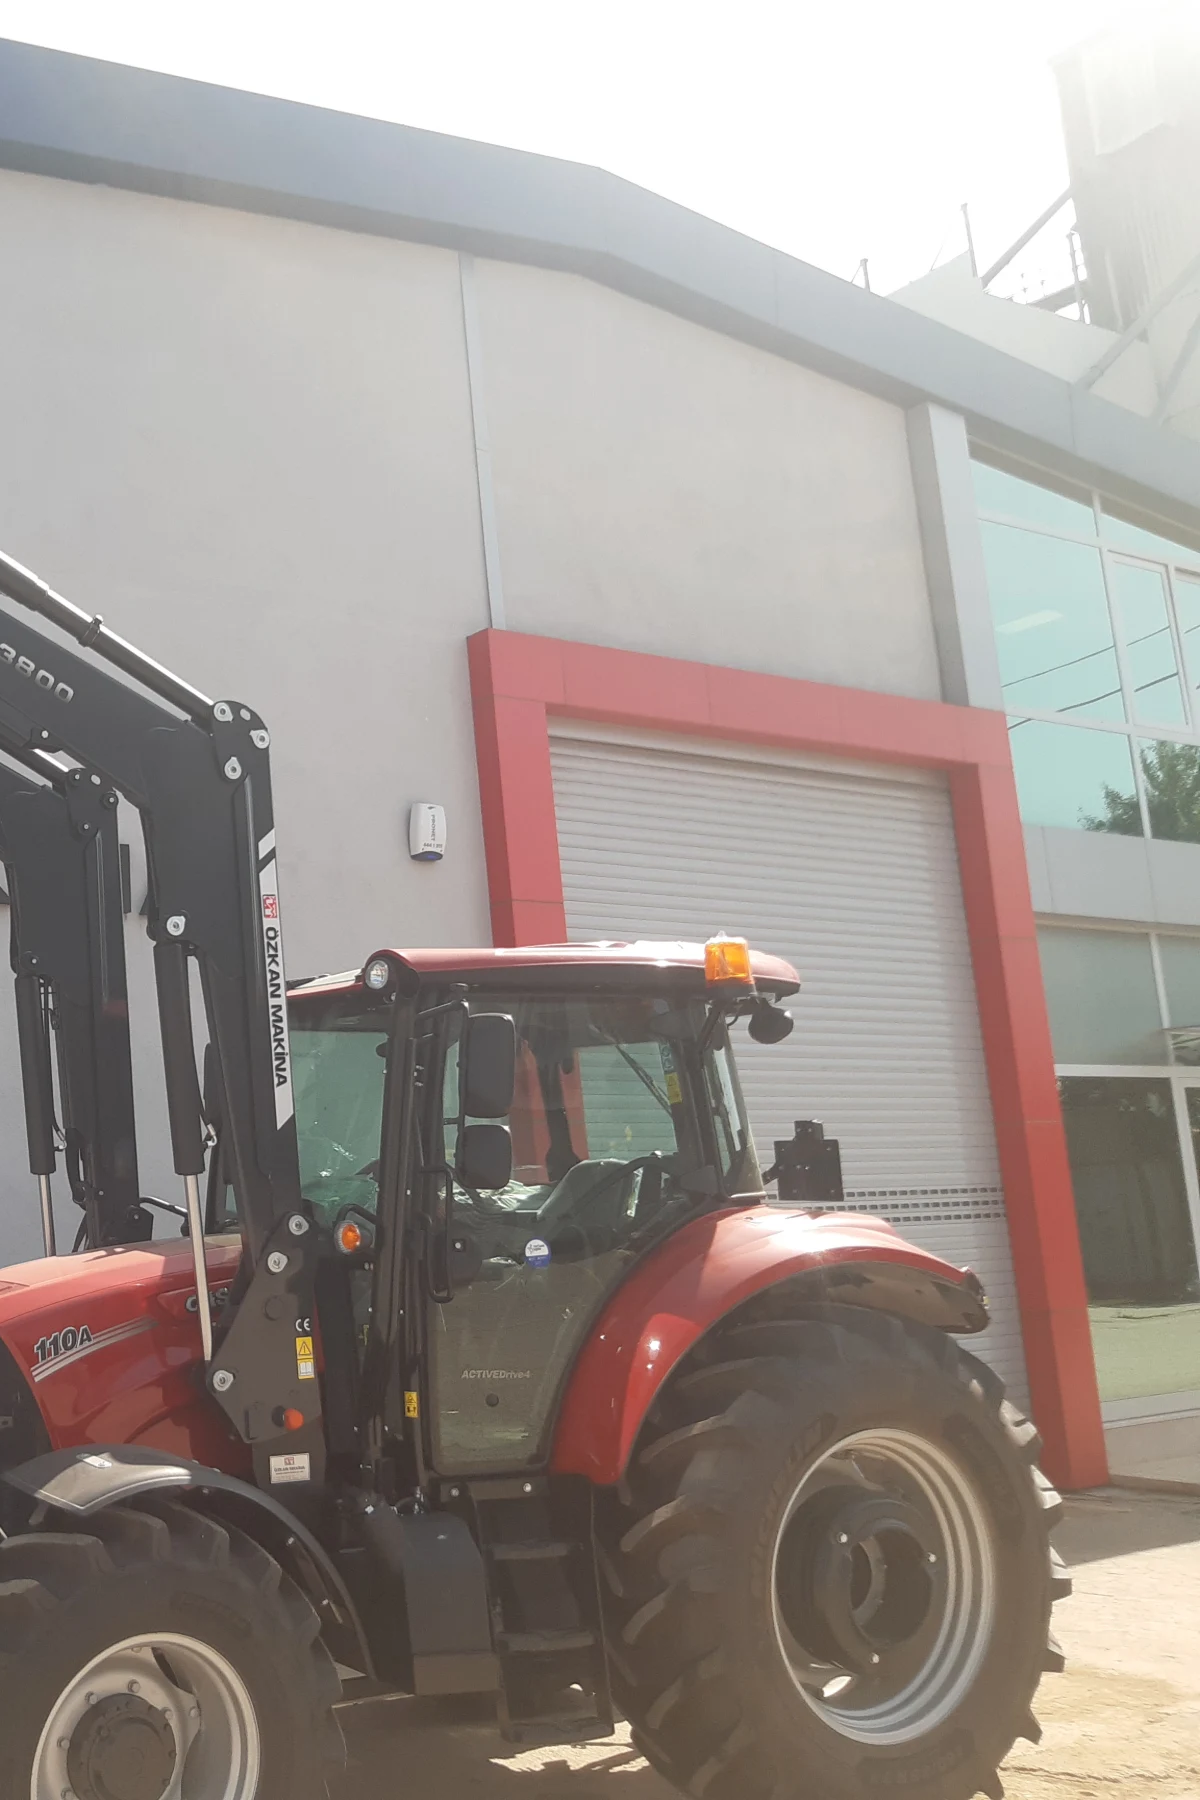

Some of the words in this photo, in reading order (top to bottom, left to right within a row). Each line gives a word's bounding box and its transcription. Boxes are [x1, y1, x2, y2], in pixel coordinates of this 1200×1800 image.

[265, 926, 282, 999] ÖZKAN
[271, 1004, 289, 1088] MAKİNA
[34, 1324, 93, 1363] 110A
[295, 1318, 311, 1332] CE
